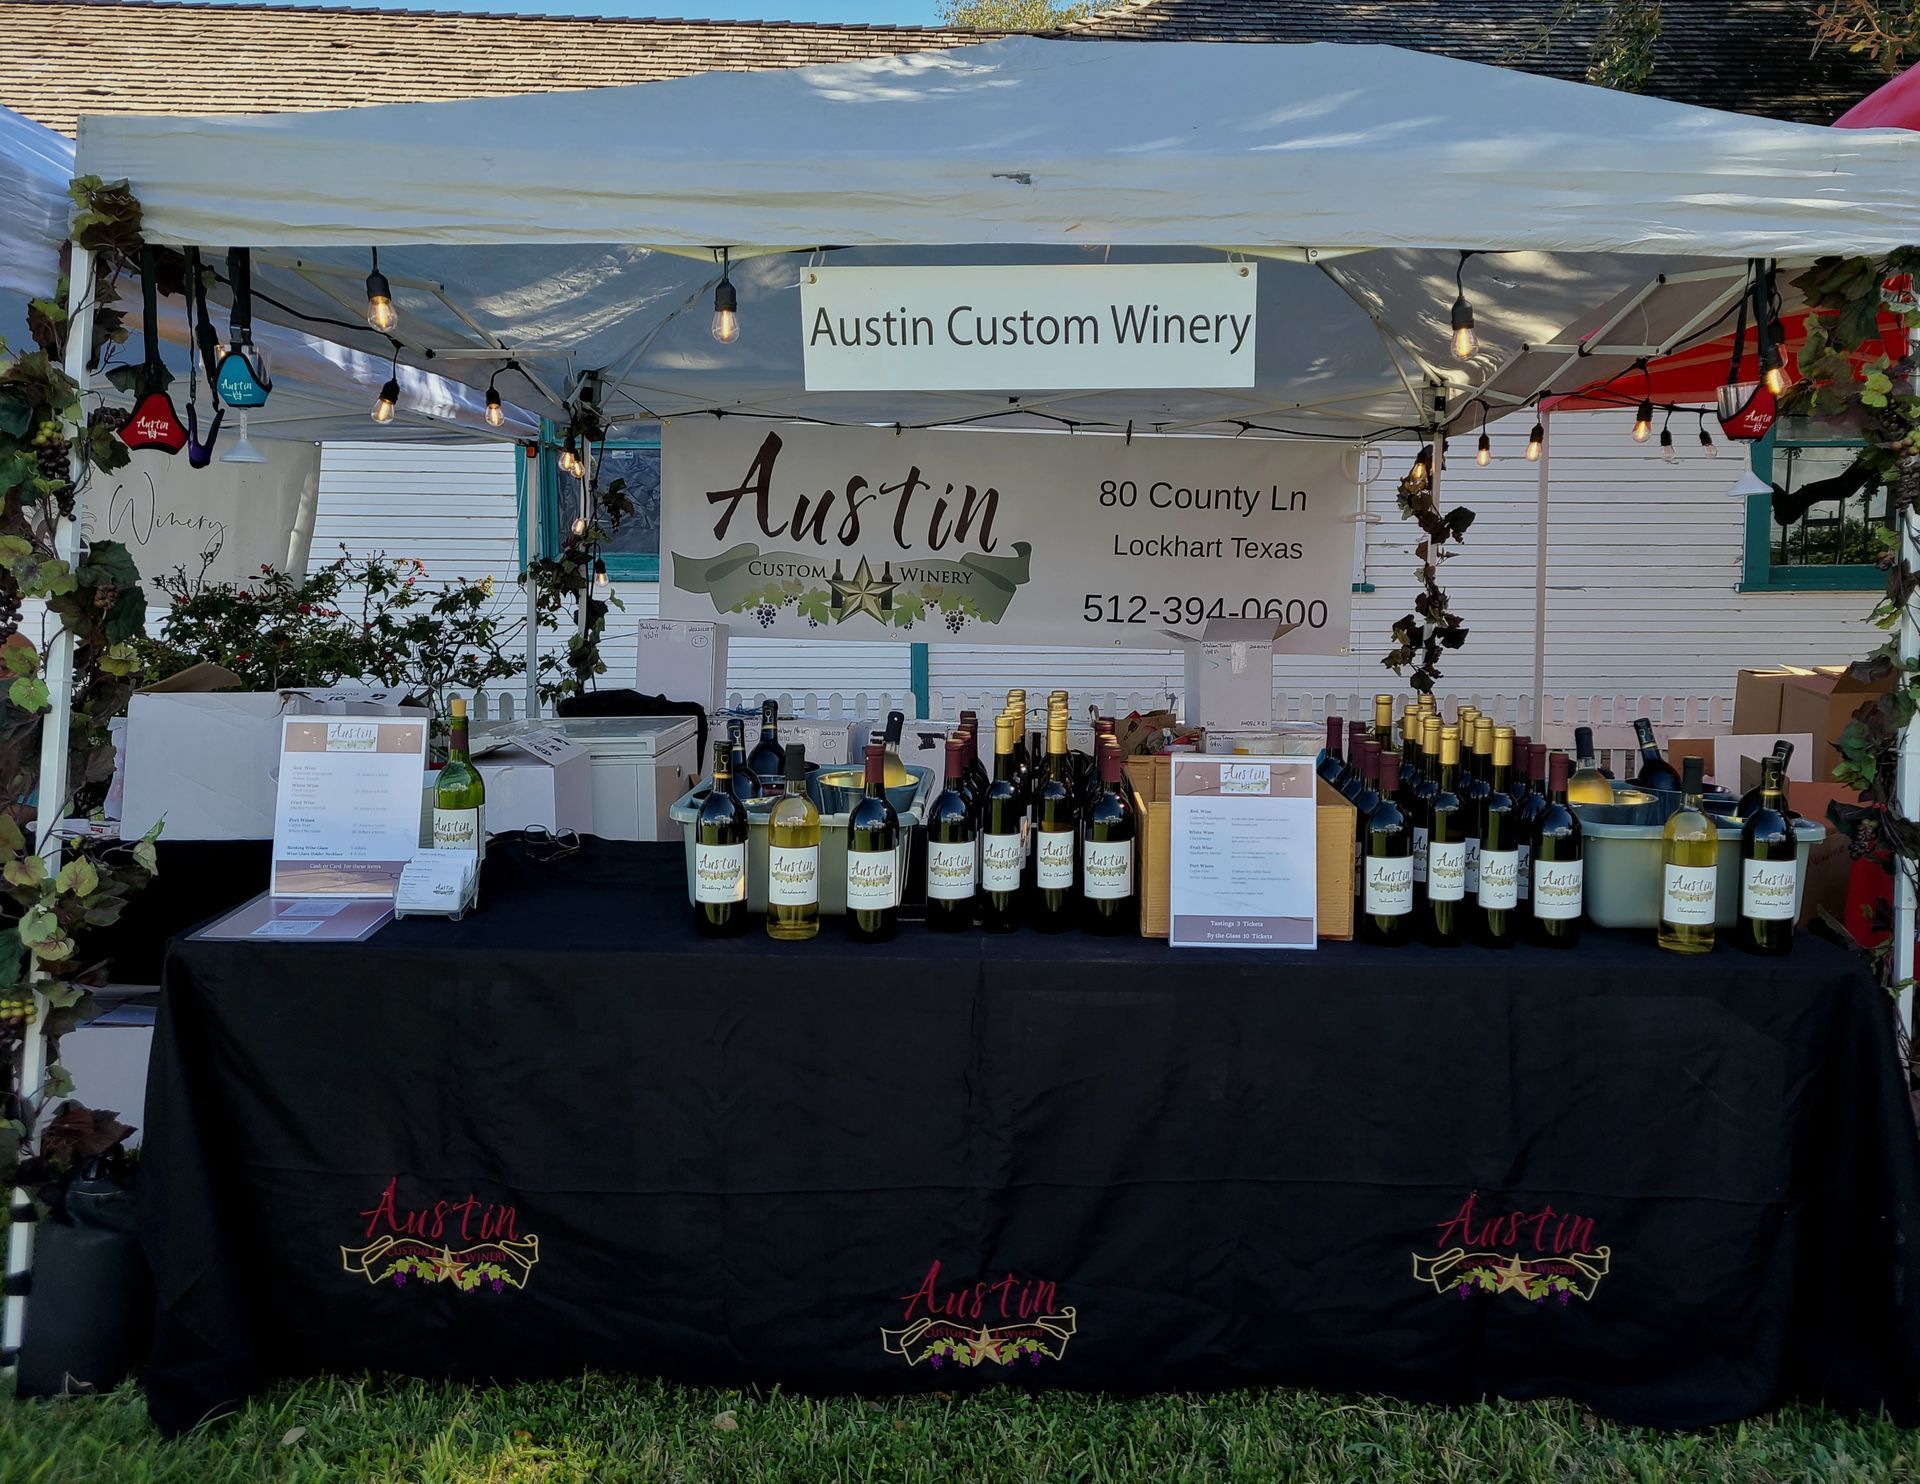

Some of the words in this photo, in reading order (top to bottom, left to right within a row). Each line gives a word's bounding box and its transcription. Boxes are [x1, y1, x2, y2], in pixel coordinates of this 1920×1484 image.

[809, 306, 934, 346] Austin
[946, 305, 1099, 346] Custom
[1110, 304, 1252, 355] Winery
[706, 430, 999, 553] Austin
[1099, 480, 1138, 508] 80
[1149, 481, 1261, 518] County
[1271, 485, 1307, 511] Ln
[108, 471, 228, 563] Winery
[1113, 534, 1223, 558] Lockhart
[1230, 536, 1304, 560] Texas
[1083, 594, 1328, 629] 512-394-0600
[331, 723, 373, 739] Austin
[1224, 763, 1265, 780] Austin
[434, 816, 471, 833] Austin
[933, 851, 970, 866] Austin
[985, 843, 1019, 859] Austin
[1088, 851, 1126, 866] Austin
[699, 853, 738, 871] Austin
[775, 856, 813, 872] Austin
[851, 860, 890, 876] Austin
[1373, 866, 1410, 882] Austin
[1542, 869, 1581, 887] Austin
[1672, 874, 1713, 891] Austin
[1752, 869, 1793, 886] Austin
[360, 1177, 519, 1242] Austin
[1435, 1191, 1595, 1254] Austin
[386, 1246, 429, 1257] CUSTOM
[465, 1251, 507, 1262] WINERY
[900, 1259, 1056, 1321] Austin
[923, 1327, 967, 1339] CUSTOM
[1003, 1328, 1044, 1339] WINERY
